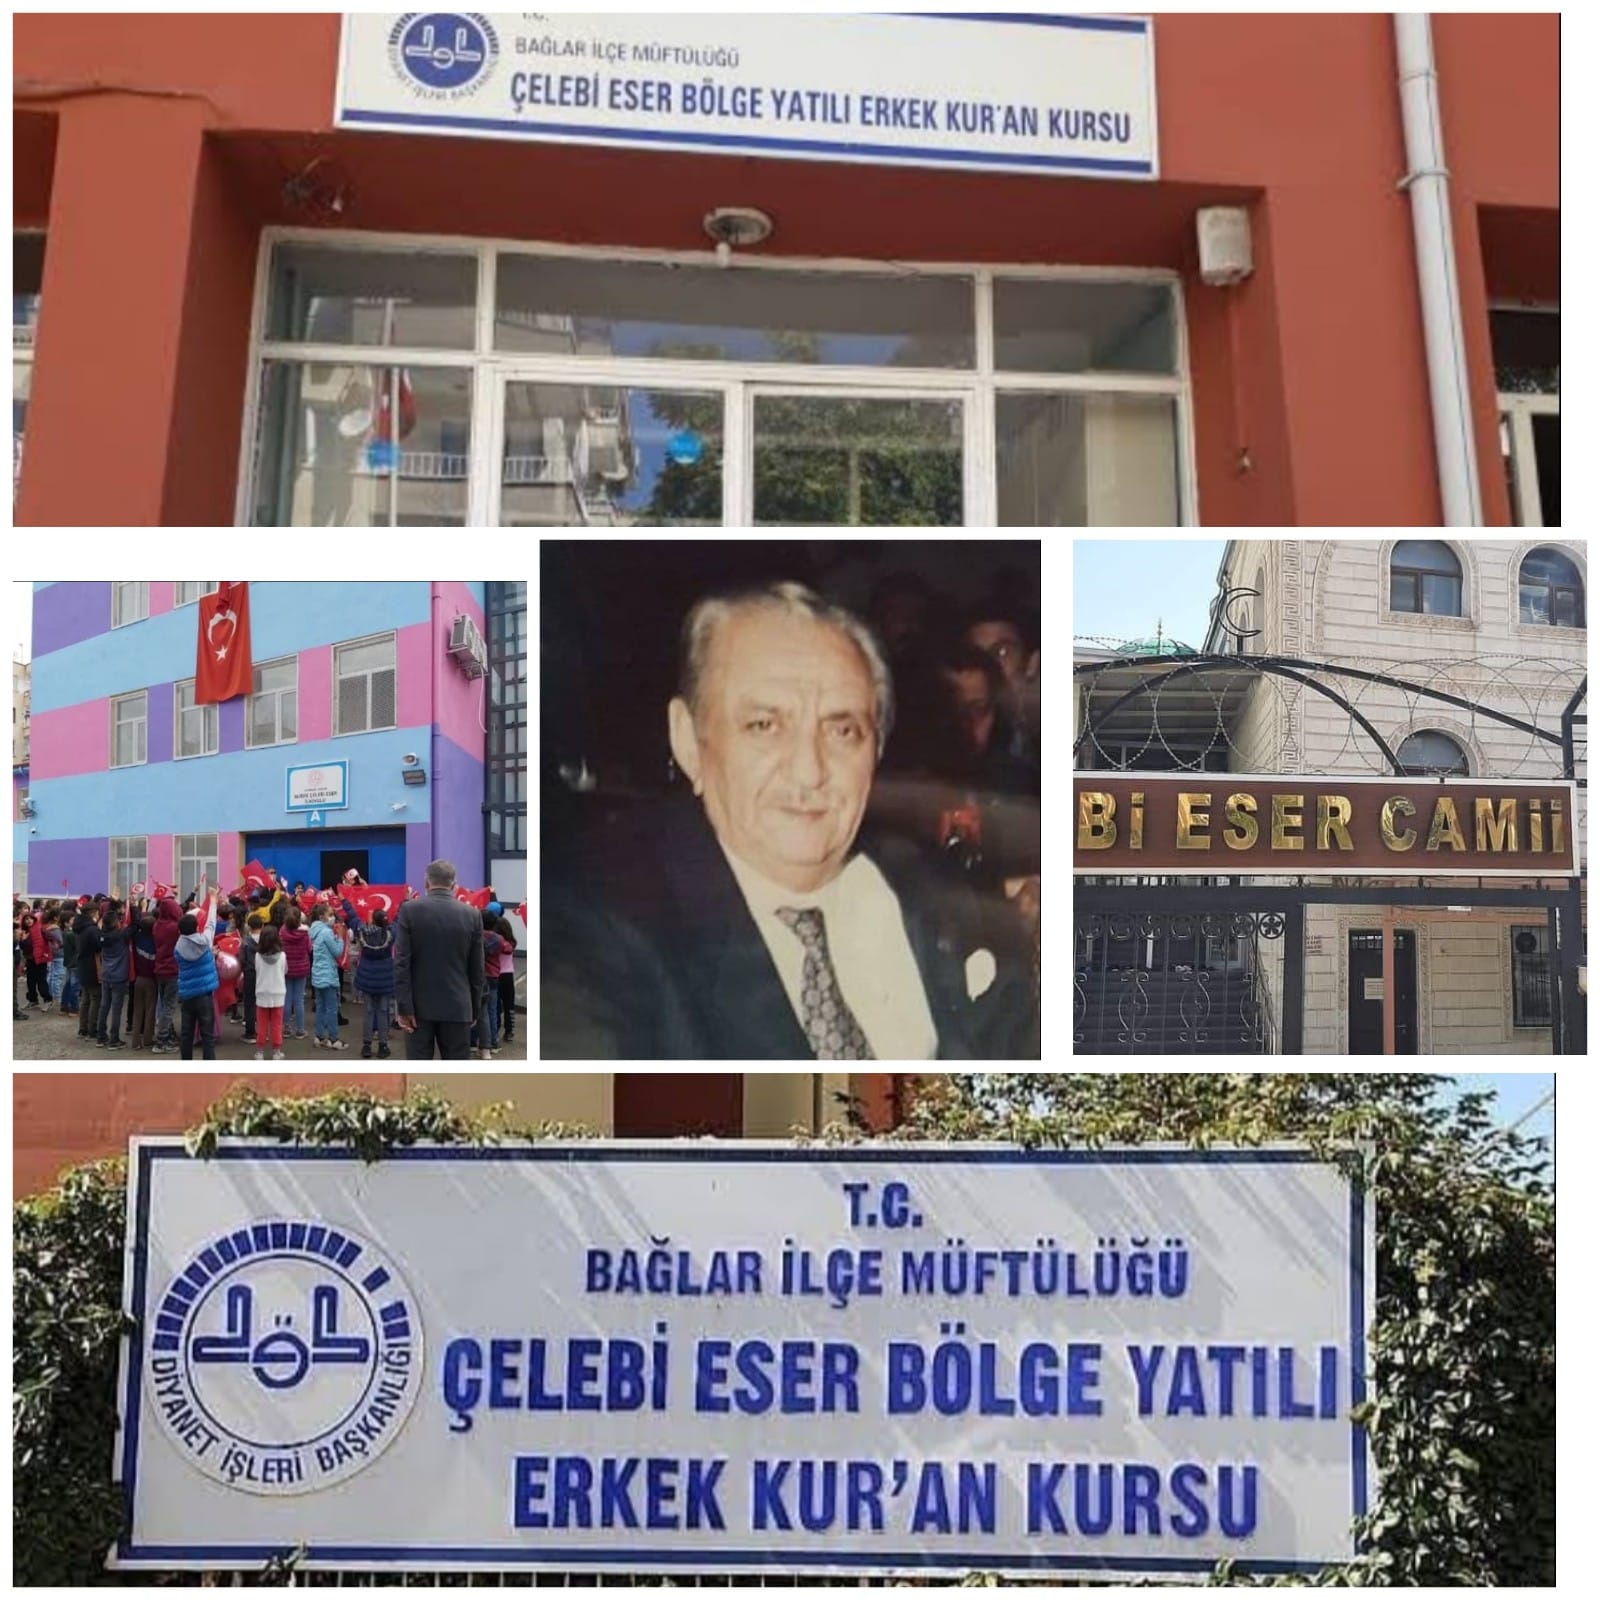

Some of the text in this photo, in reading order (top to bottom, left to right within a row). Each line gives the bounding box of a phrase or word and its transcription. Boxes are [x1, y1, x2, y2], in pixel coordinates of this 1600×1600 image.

[515, 35, 740, 68] BAĞLAR İLÇE MÜFTÜLÜĞÜ
[510, 71, 599, 113] ÇELEBİ
[608, 79, 673, 113] ESER
[682, 77, 763, 118] BÖLGE
[771, 88, 851, 125] YATILI
[860, 95, 938, 131] ERKEK
[1048, 108, 1131, 143] KURSU
[1176, 792, 1354, 852] ESER
[843, 1182, 923, 1228] T.C.
[586, 1235, 1189, 1309] BAĞLAR İLÇE MÜFTÜLÜĞÜ
[151, 1341, 411, 1484] DİYANET İŞLERİ BAŞKANLIĞI
[442, 1321, 1338, 1433] ÇELEBİ ESER BÖLGE YATILI
[514, 1455, 727, 1531] ERKEK
[1026, 1462, 1258, 1539] KURSU
